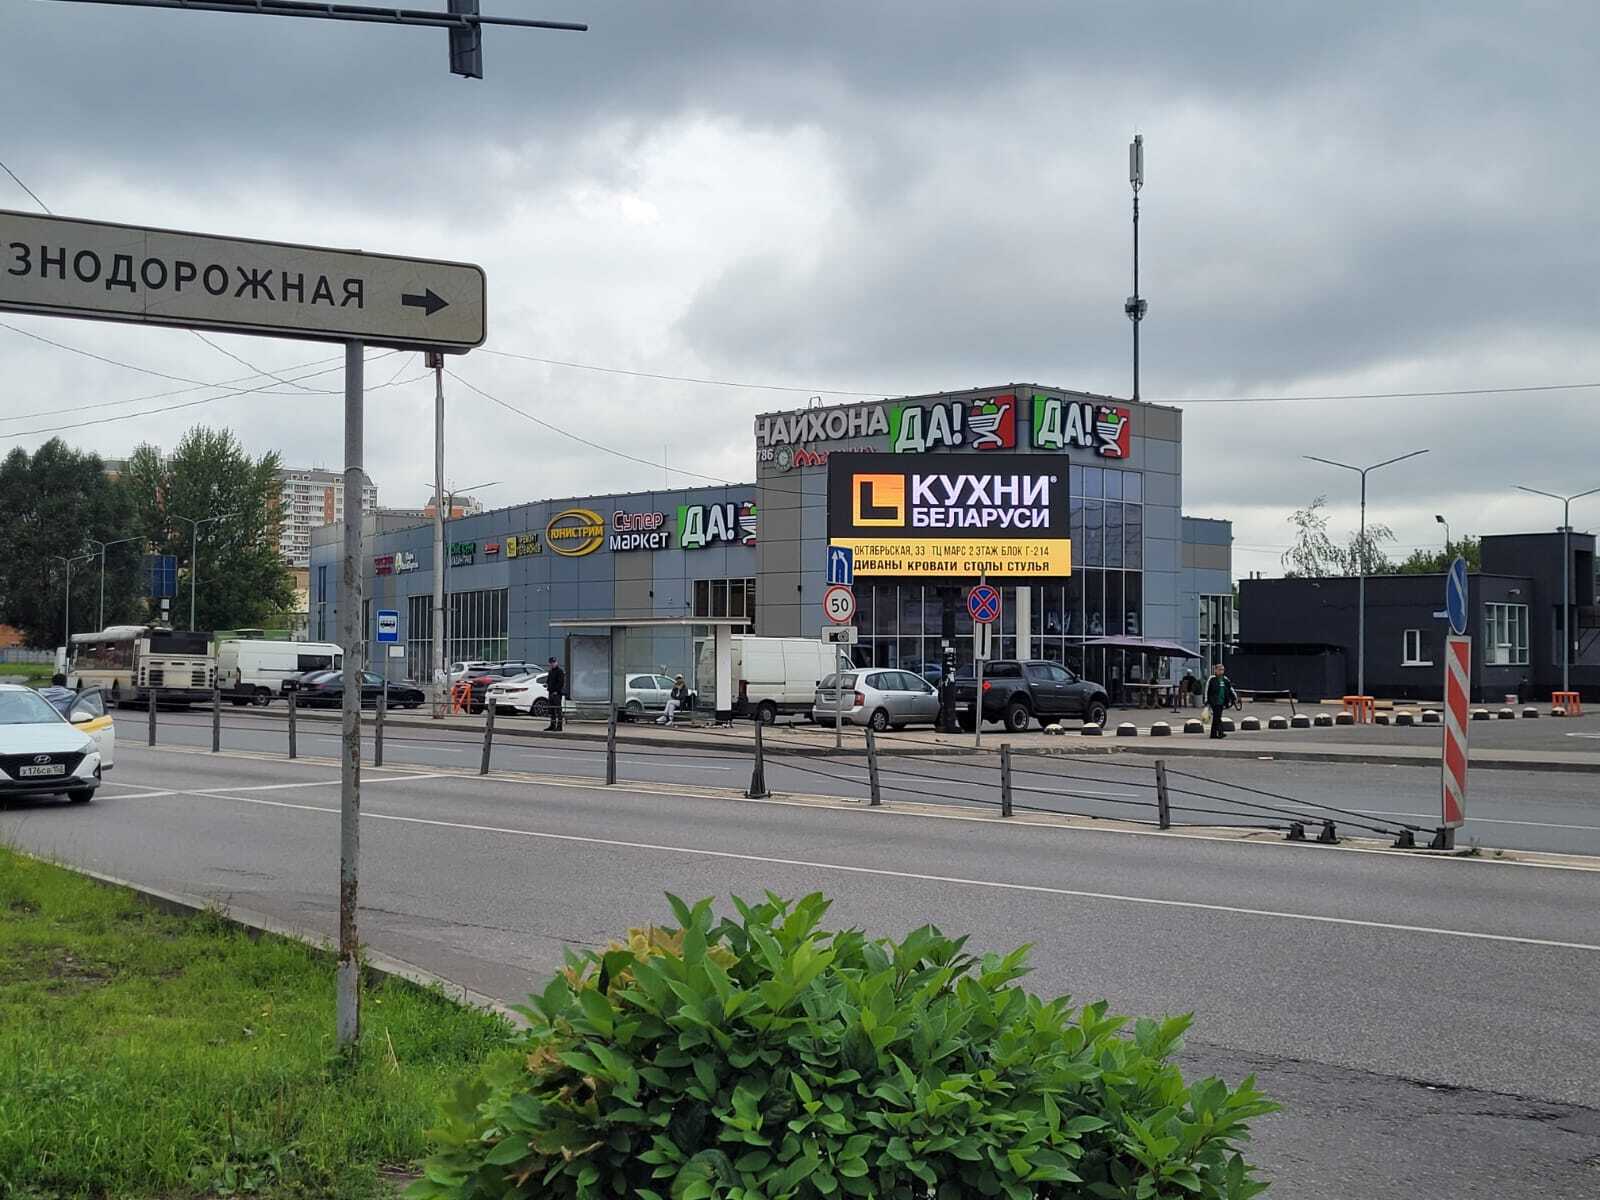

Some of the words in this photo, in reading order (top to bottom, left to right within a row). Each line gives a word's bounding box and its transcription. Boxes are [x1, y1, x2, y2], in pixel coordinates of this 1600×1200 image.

[895, 402, 963, 453] ДА!
[1038, 398, 1093, 448] ДА!
[912, 474, 1050, 506] КУХНИ
[612, 510, 664, 532] Супер
[681, 503, 735, 547] ДА!
[912, 507, 1050, 528] БЕЛАРУСИ
[550, 525, 604, 540] ЮНИСТРИМ
[609, 532, 669, 551] маркет
[854, 545, 914, 557] ОКТЯБРЬСКАЯ,
[915, 545, 925, 556] 33
[932, 545, 942, 557] ТЦ
[944, 545, 966, 556] МАРС
[968, 545, 974, 556] 2
[975, 545, 999, 556] ЭТАЖ
[1001, 545, 1023, 556] БЛОК
[1025, 545, 1049, 556] Г-214
[854, 559, 902, 571] ДИВАНЫ
[907, 561, 958, 571] КРОВАТИ
[964, 561, 1003, 571] СТОЛЫ
[1007, 561, 1049, 571] СТУЛЬЯ
[831, 598, 849, 613] 50
